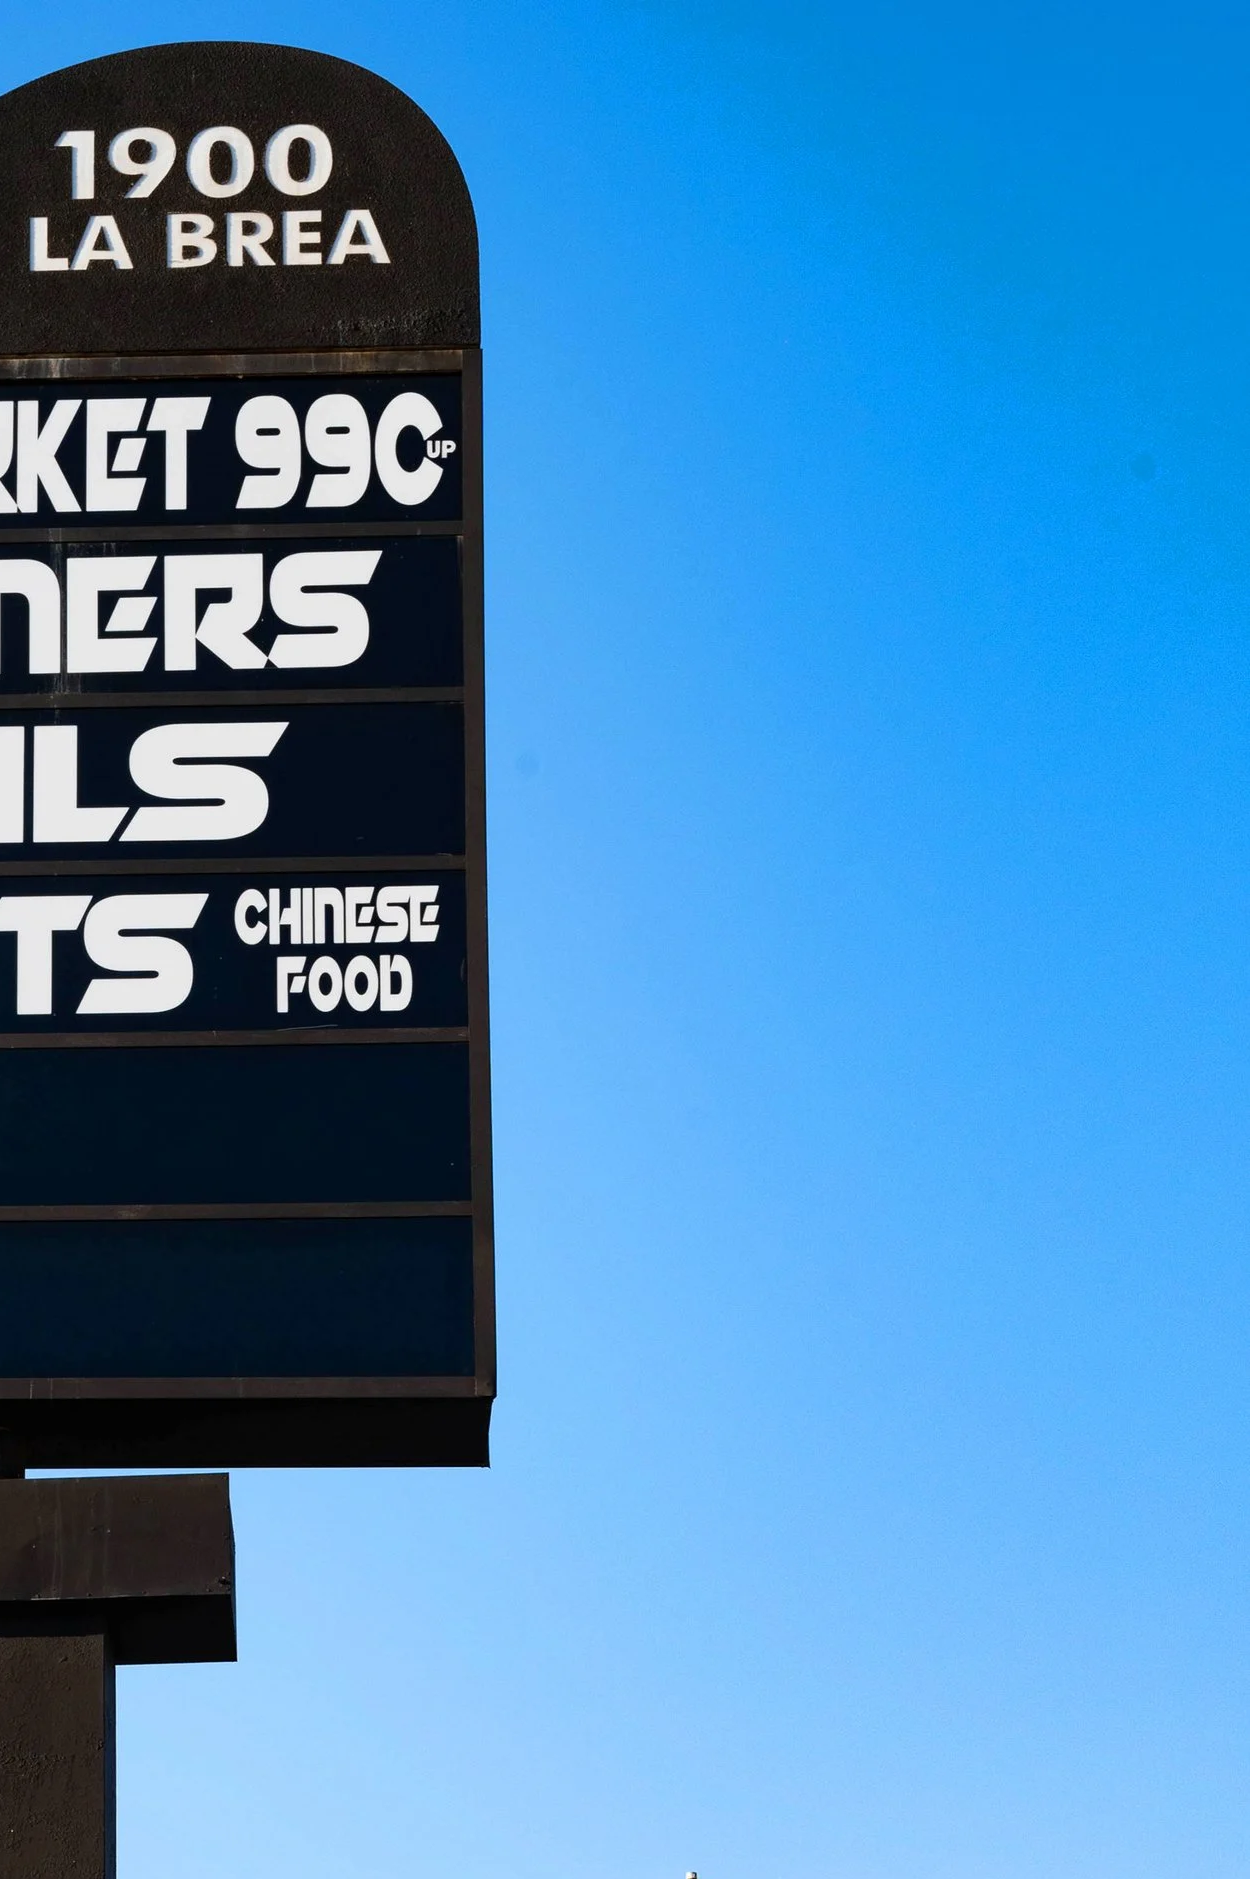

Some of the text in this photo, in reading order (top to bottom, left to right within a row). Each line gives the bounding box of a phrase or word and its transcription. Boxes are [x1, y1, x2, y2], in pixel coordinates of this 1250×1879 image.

[55, 123, 333, 200] 1900
[30, 209, 391, 272] LA BREA
[426, 440, 457, 459] UP
[234, 885, 441, 945] CHINESE
[276, 954, 414, 1013] FOOD
